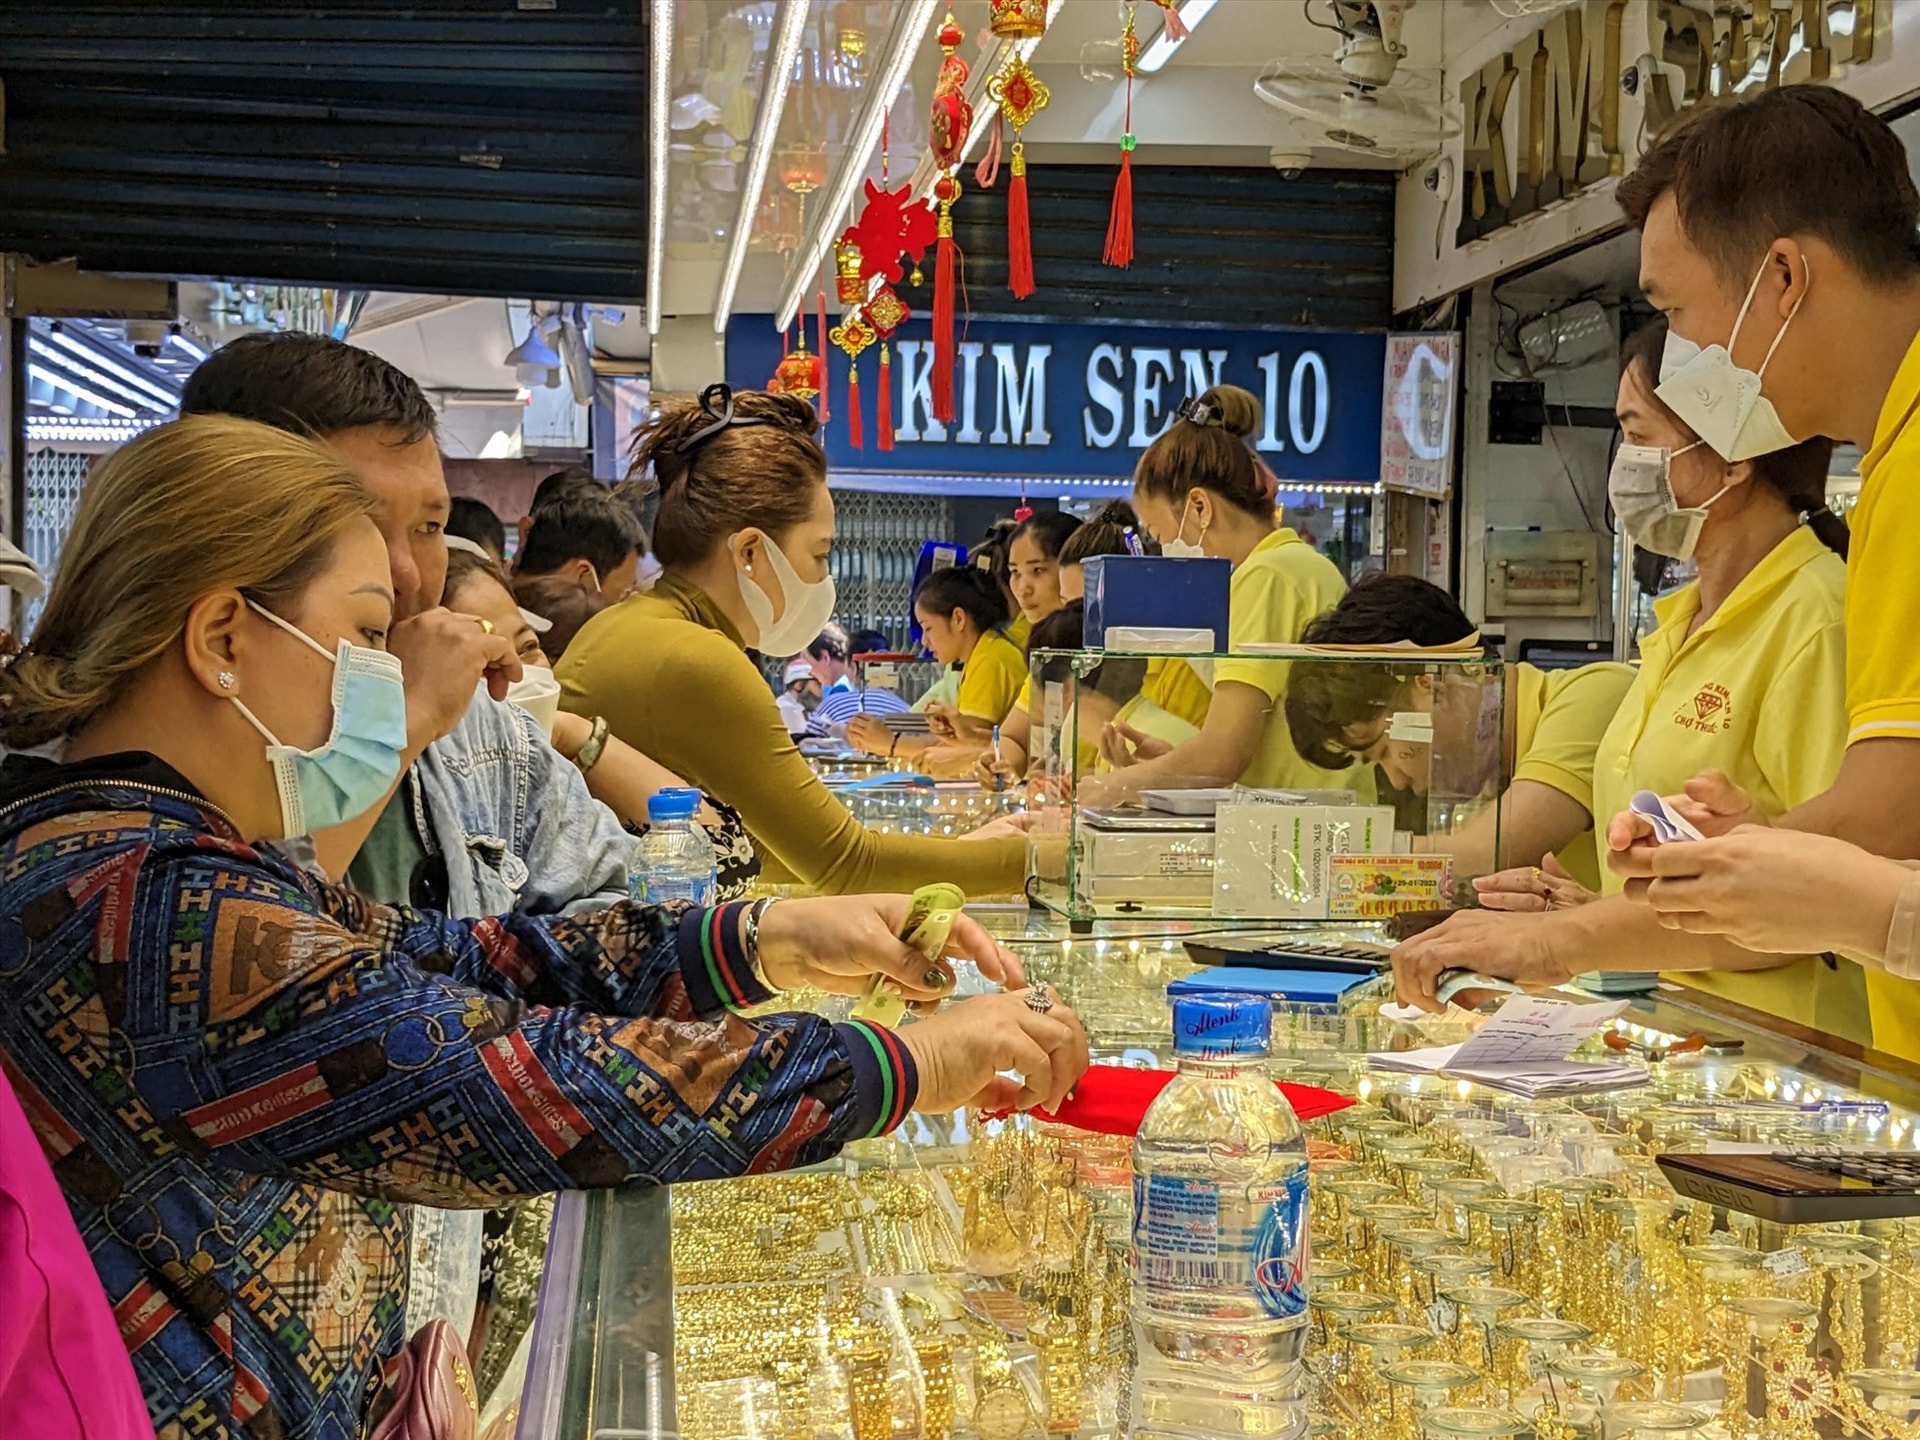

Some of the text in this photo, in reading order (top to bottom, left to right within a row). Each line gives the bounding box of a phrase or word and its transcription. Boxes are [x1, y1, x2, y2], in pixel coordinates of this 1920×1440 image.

[894, 340, 1052, 447] KIM
[1255, 350, 1330, 454] 10
[1397, 879, 1437, 887] 29-01-2023
[1684, 1177, 1756, 1212] CASIO
